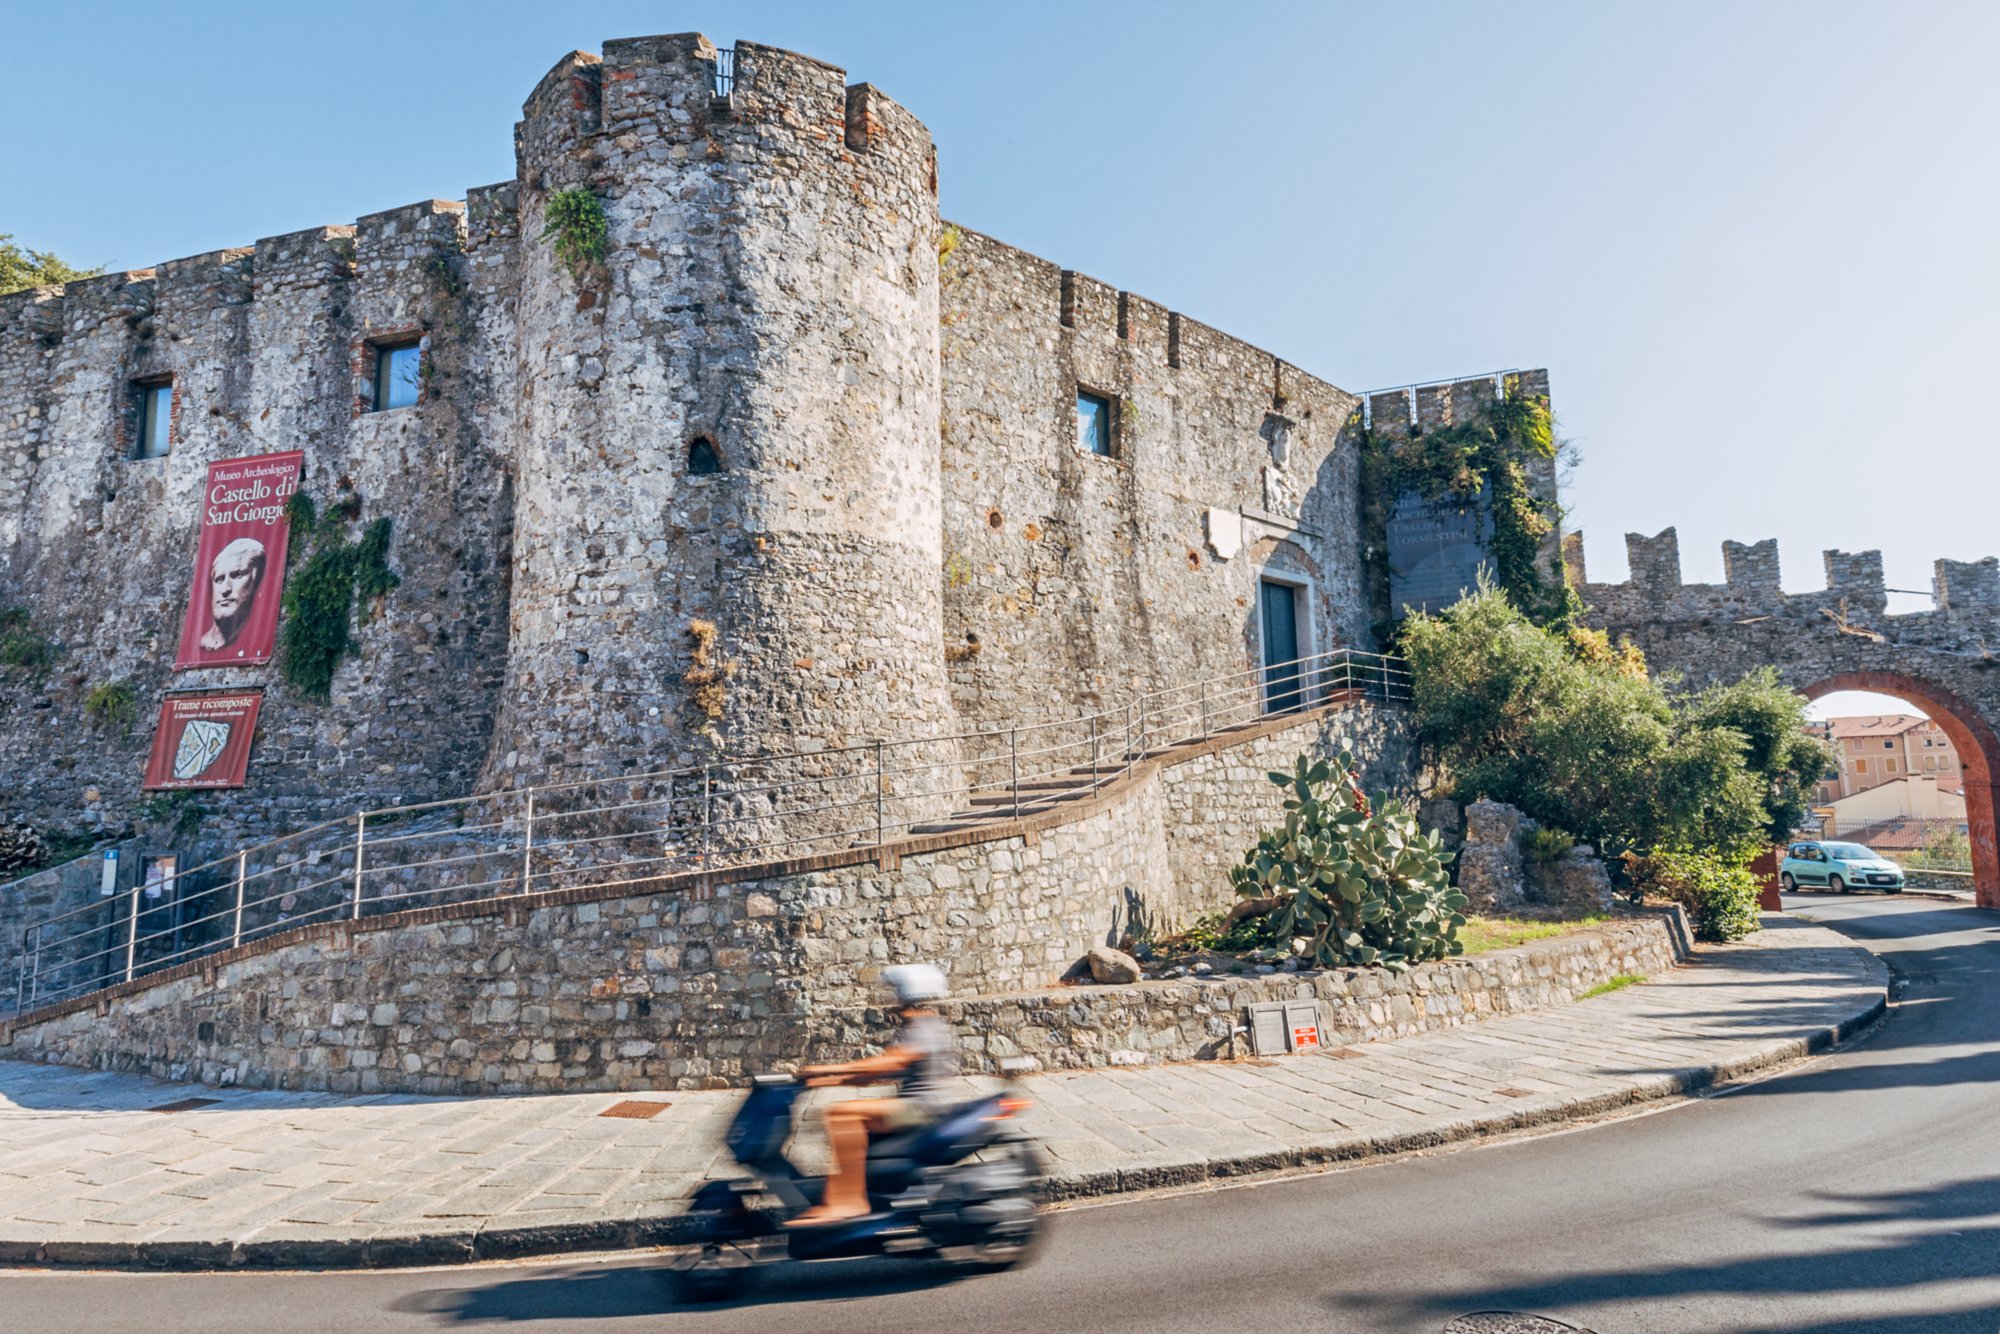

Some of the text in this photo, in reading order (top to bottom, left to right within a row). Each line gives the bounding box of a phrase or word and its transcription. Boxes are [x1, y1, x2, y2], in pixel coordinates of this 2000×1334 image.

[214, 462, 295, 482] Museo Archeologico
[210, 476, 293, 505] Castello di
[206, 505, 232, 526] San
[173, 698, 253, 711] Trame ricomposte
